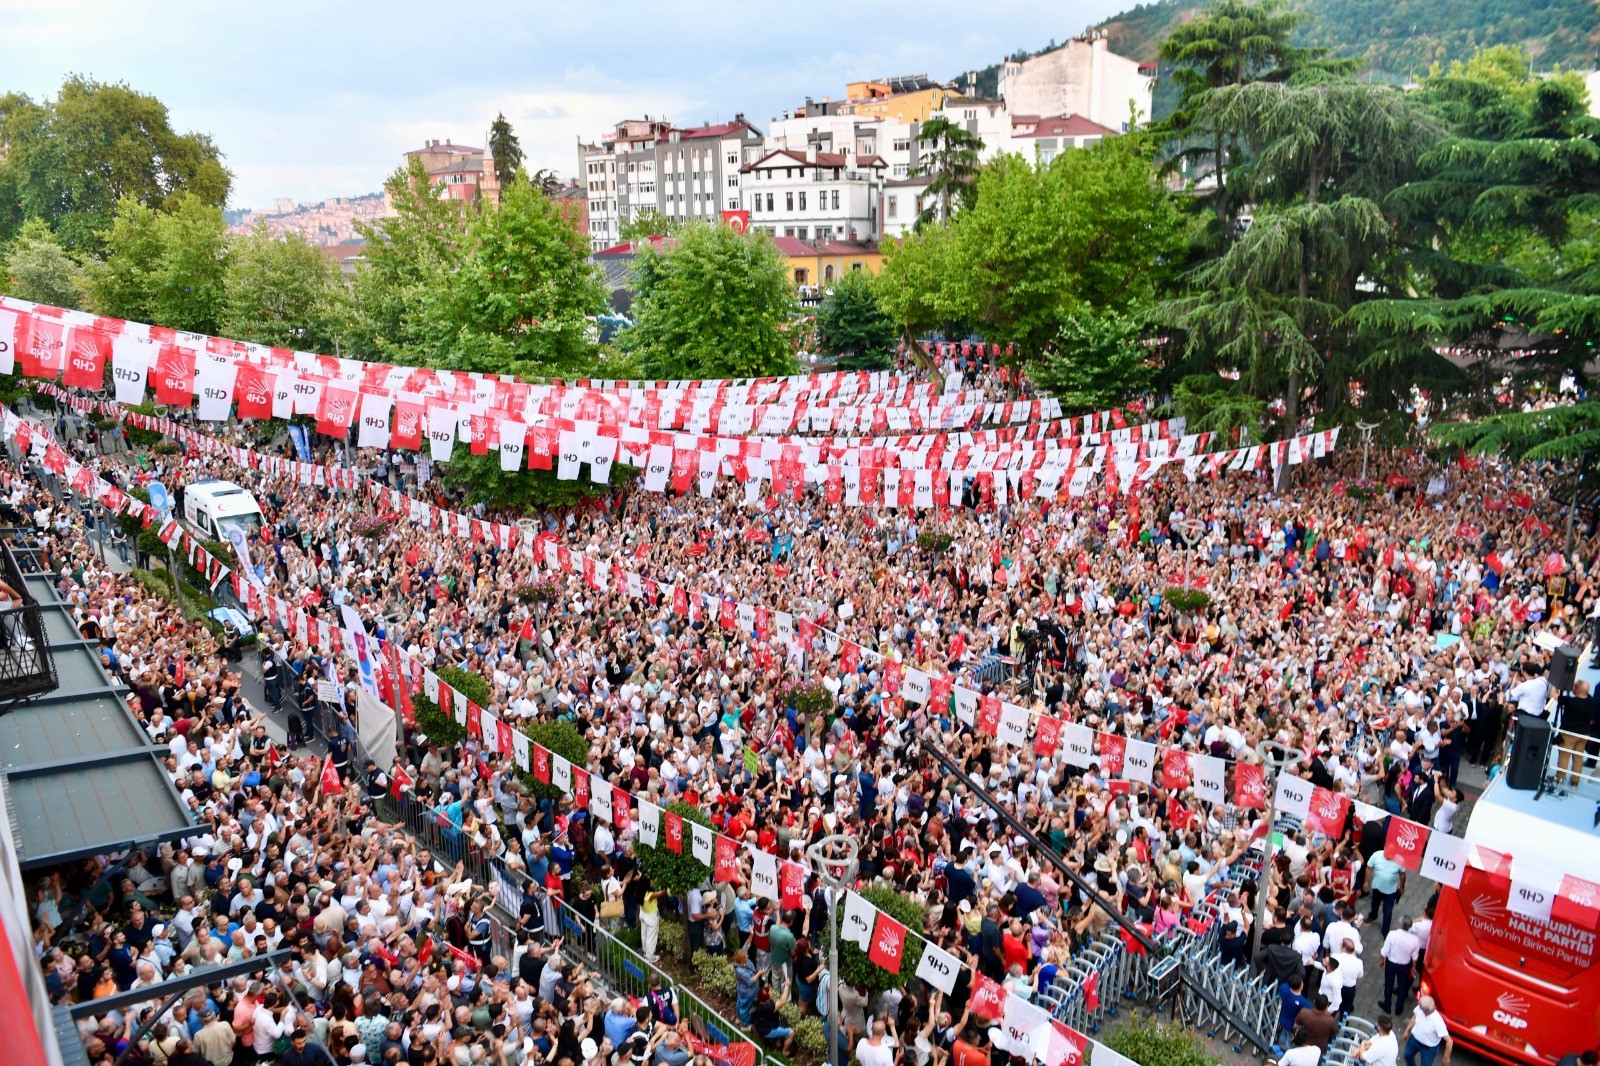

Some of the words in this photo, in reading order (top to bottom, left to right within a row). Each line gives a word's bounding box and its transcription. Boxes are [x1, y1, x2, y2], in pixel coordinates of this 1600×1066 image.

[462, 419, 471, 428] CH
[595, 456, 609, 465] CHP
[650, 465, 665, 474] CHP
[1470, 916, 1521, 944] Türkiye'nin
[1523, 936, 1555, 956] Birinci
[1557, 949, 1590, 968] Partisi
[1508, 918, 1542, 938] HALK
[1544, 930, 1594, 956] PARTİSİ
[1492, 1009, 1528, 1029] CHP
